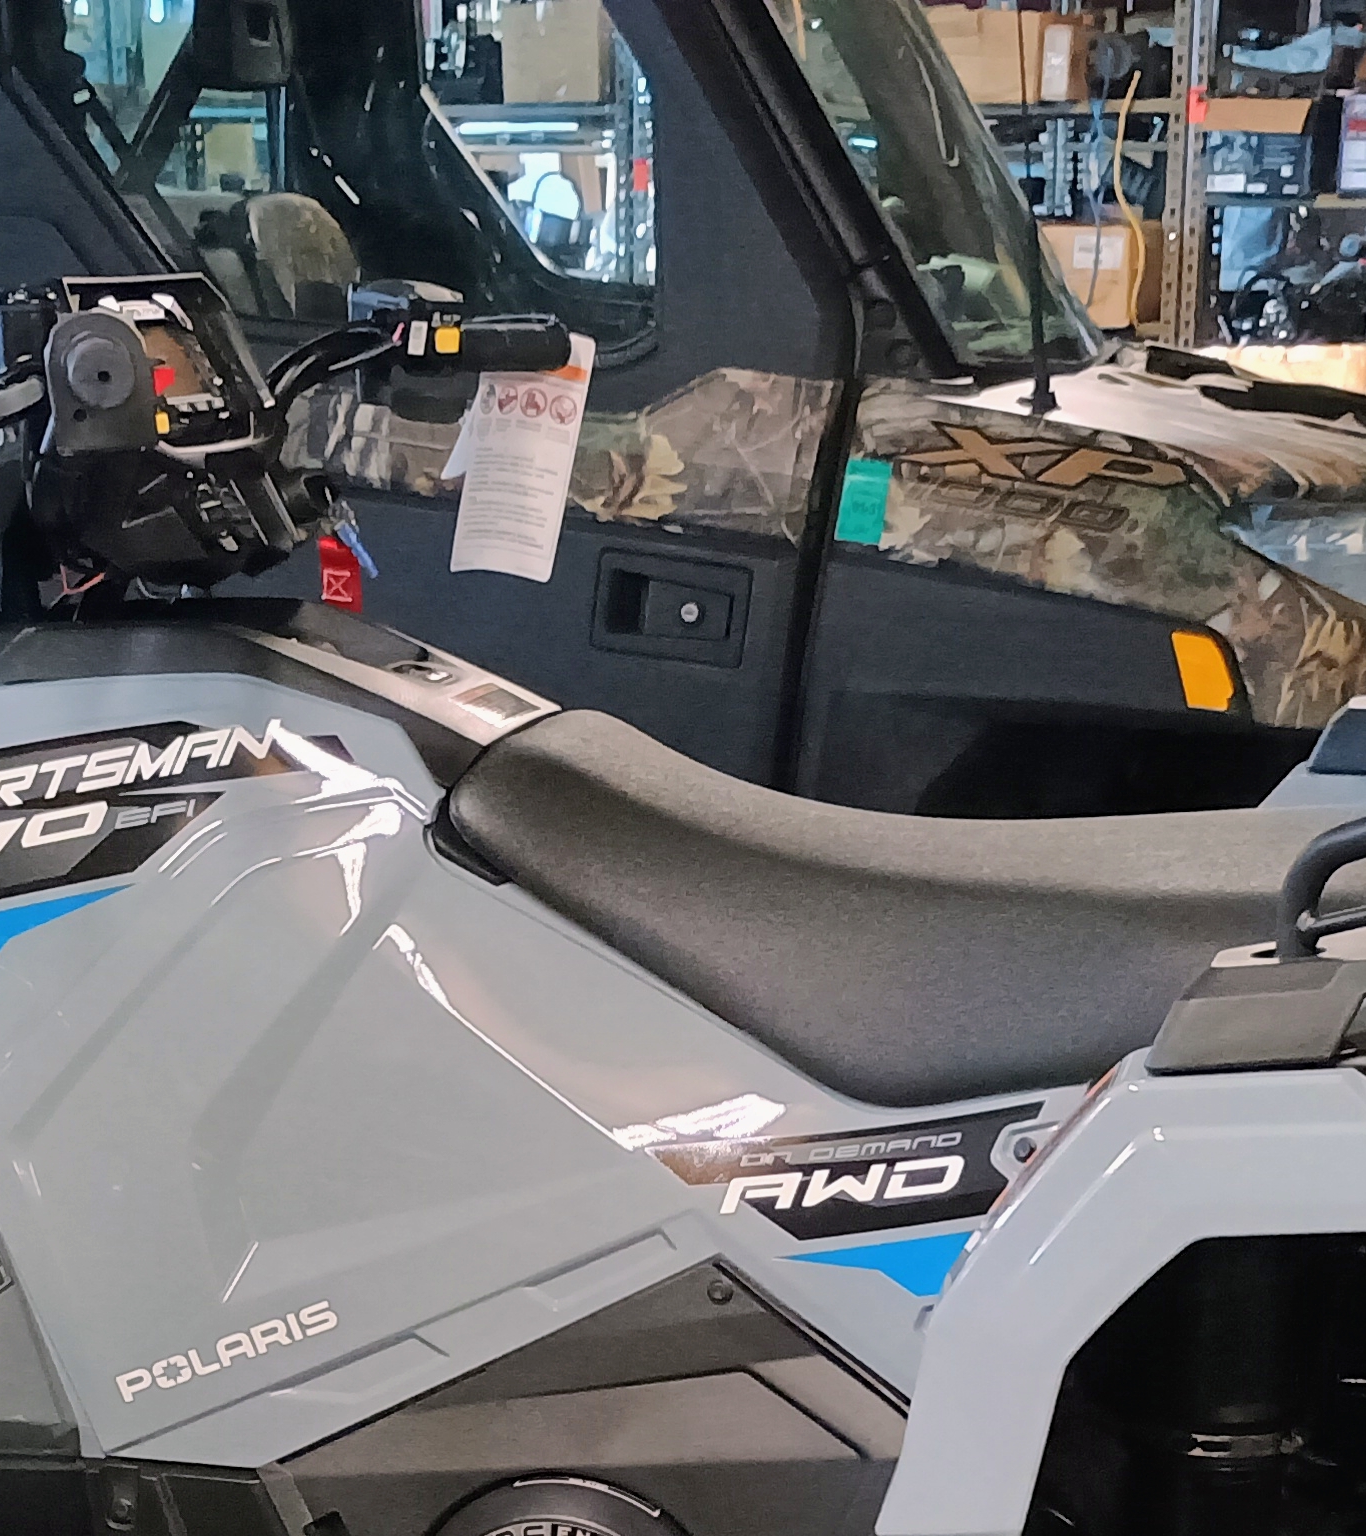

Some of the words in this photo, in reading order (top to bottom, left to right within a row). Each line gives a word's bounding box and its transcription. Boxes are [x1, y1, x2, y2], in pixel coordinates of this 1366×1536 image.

[893, 420, 1187, 489] XP
[114, 798, 195, 831] EFI
[739, 1150, 792, 1168] ON
[807, 1131, 963, 1163] DEMAND
[719, 1154, 966, 1216] AWD
[114, 1299, 339, 1404] POLARIS
